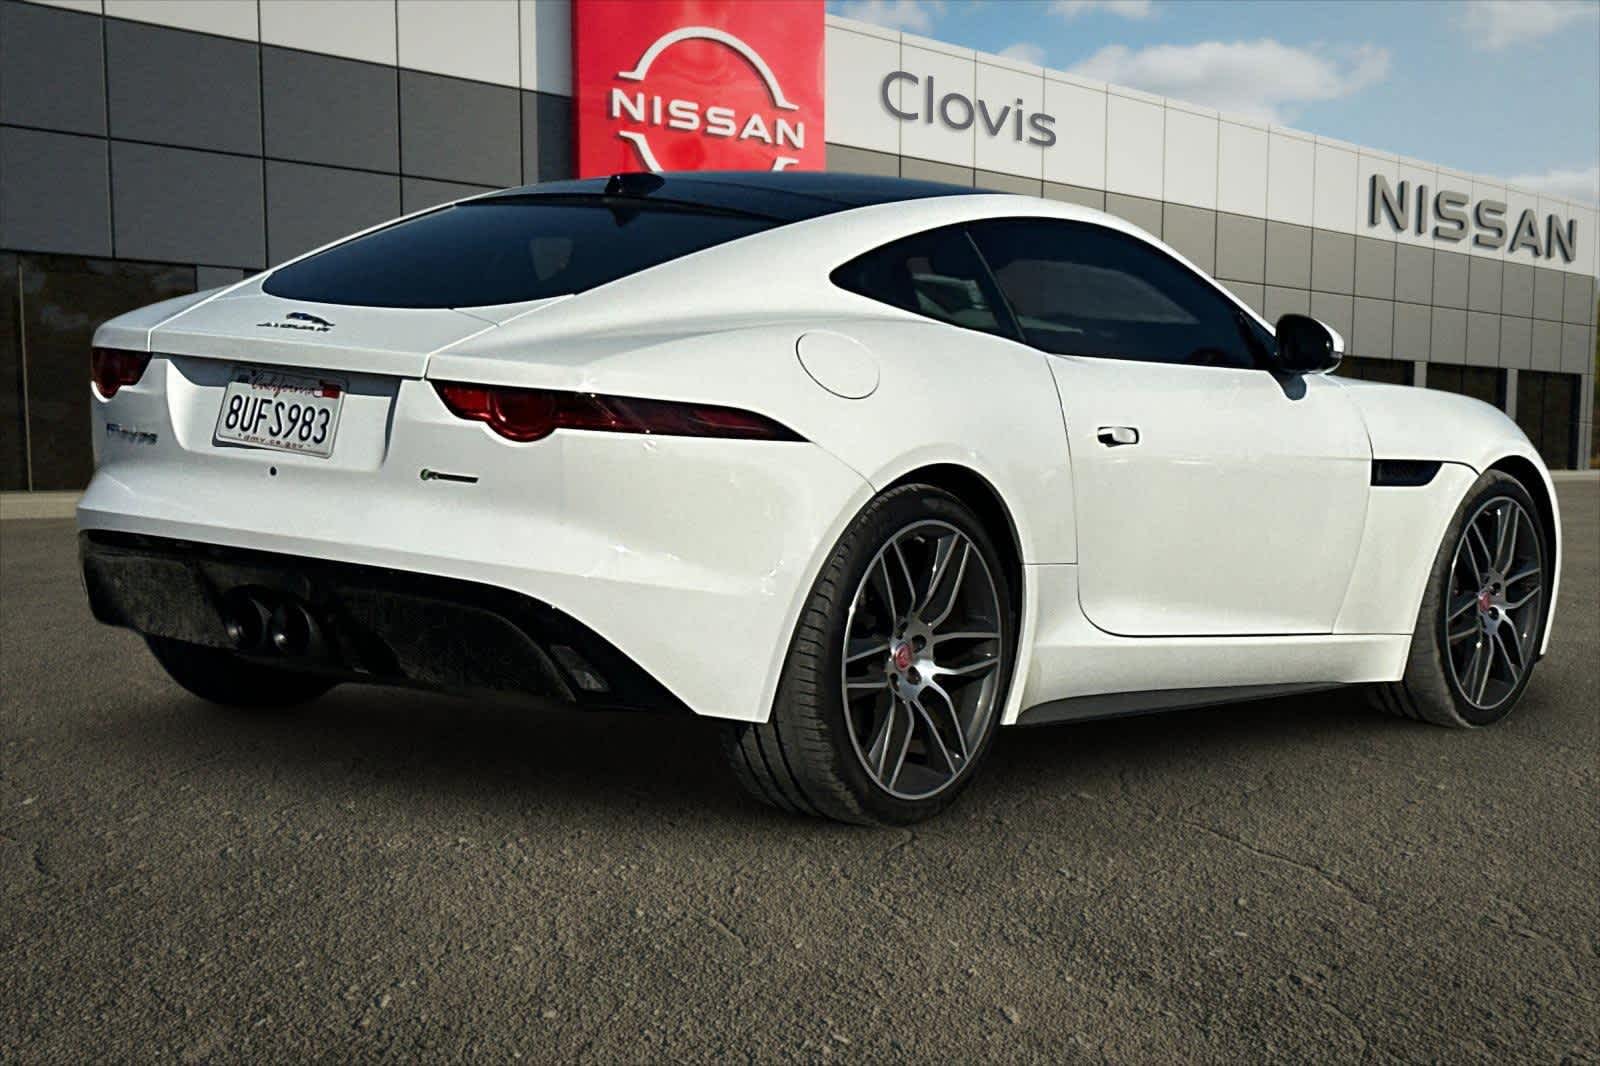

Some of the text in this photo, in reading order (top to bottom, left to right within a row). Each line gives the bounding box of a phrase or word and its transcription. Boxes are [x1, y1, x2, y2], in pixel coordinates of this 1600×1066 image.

[611, 88, 805, 149] NISSAN
[881, 70, 1057, 147] Clovis
[1368, 173, 1578, 263] NISSAN
[225, 394, 331, 444] 8UFS983
